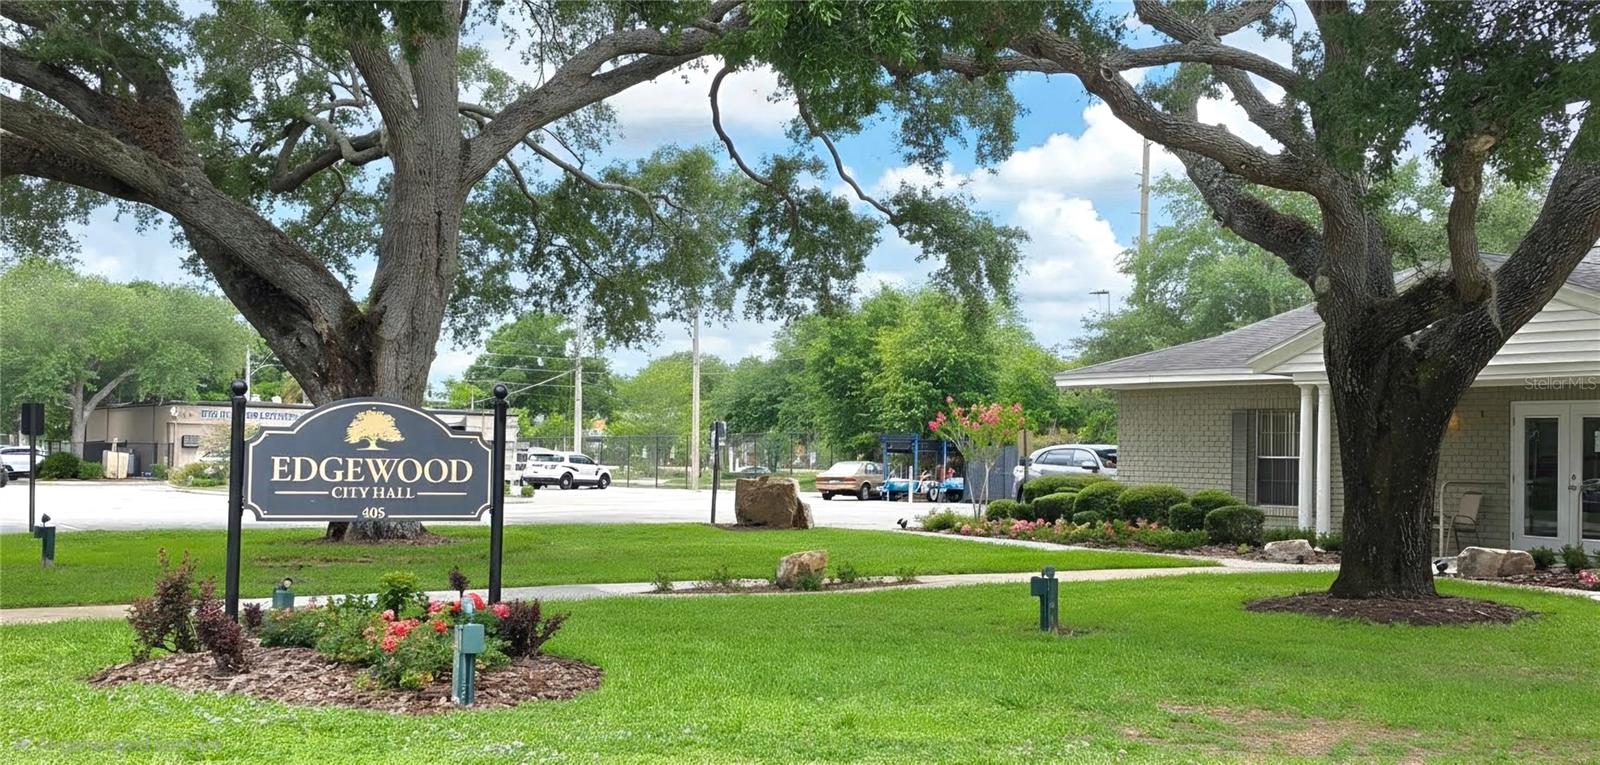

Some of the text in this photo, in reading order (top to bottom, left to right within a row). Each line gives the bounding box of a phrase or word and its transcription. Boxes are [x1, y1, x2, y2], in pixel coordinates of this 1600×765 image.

[270, 456, 473, 483] EDGEWOOD
[331, 486, 415, 499] CITY HALL
[362, 507, 386, 519] 405
